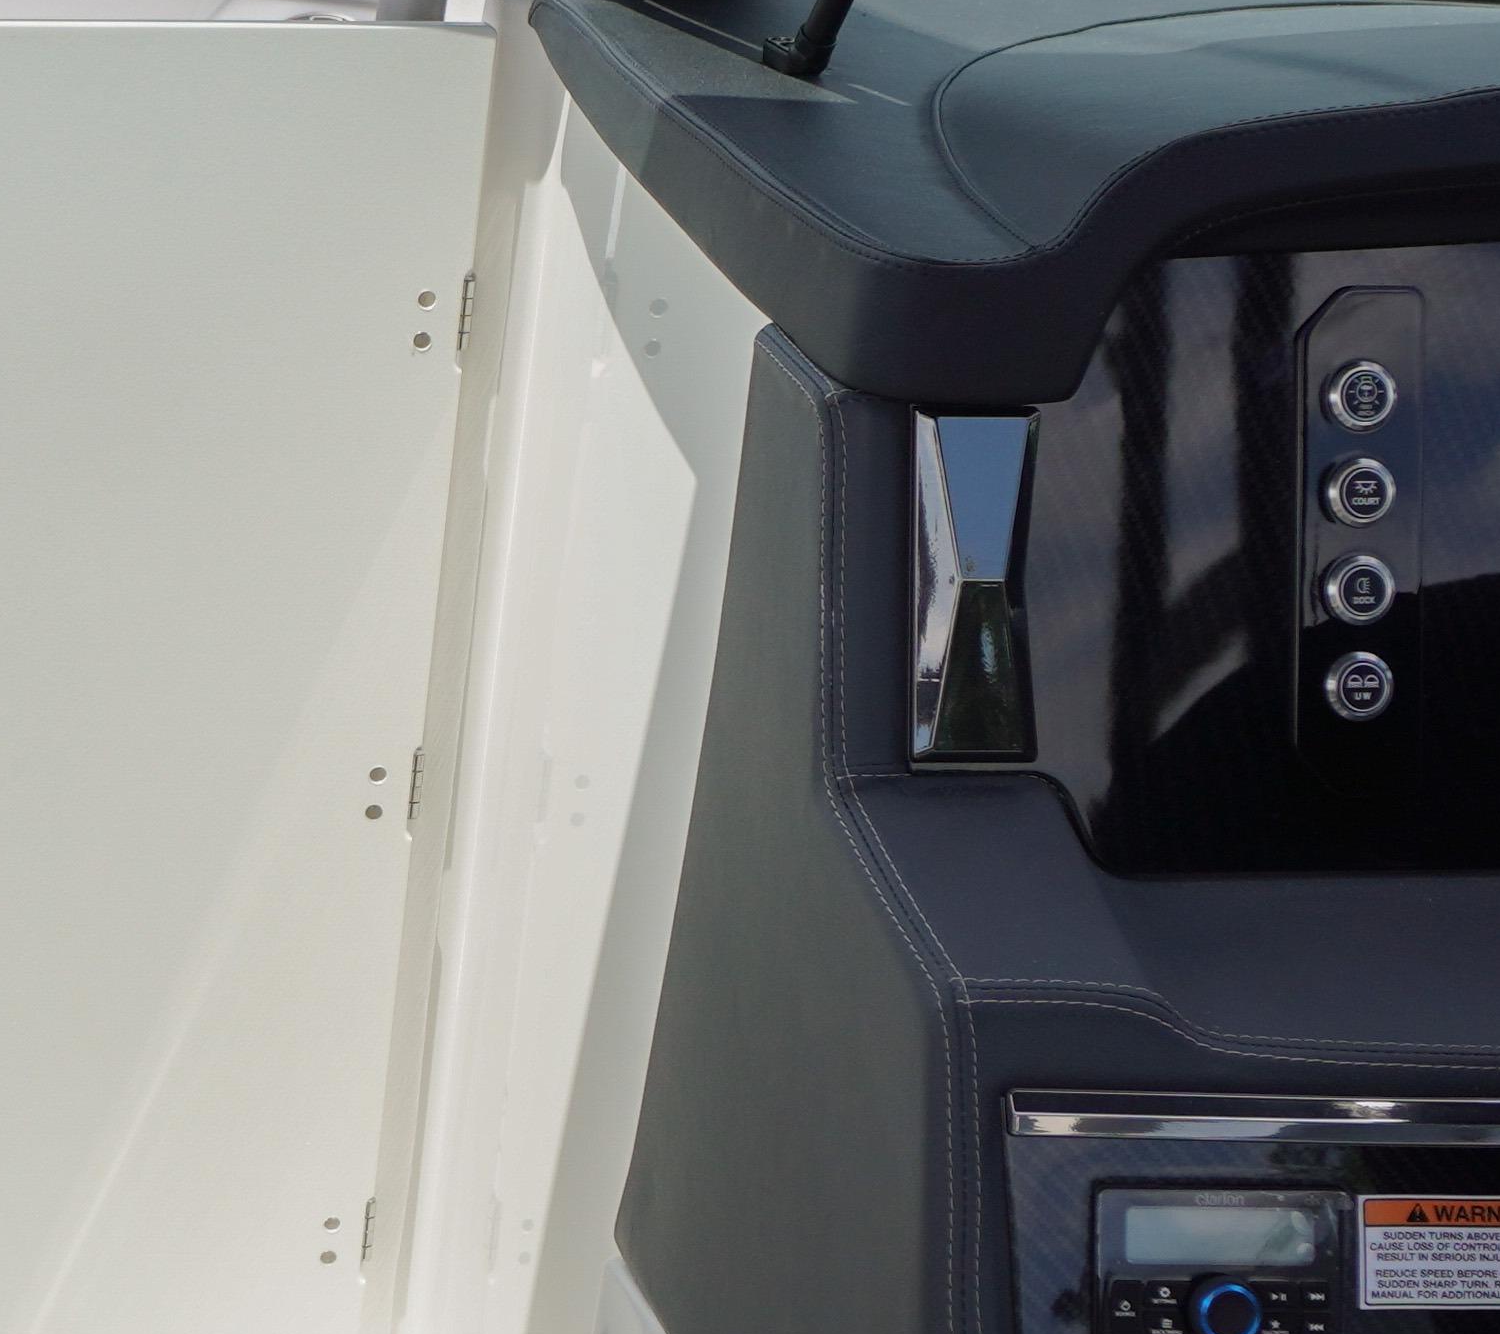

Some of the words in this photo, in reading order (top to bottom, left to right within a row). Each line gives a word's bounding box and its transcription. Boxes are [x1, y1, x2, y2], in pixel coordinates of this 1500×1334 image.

[1352, 496, 1380, 505] COURT
[1383, 1231, 1425, 1241] SUDDEN
[1429, 1231, 1463, 1241] TURNS
[1467, 1231, 1500, 1242] ABOVE
[1369, 1241, 1403, 1252] CAUSE
[1407, 1242, 1433, 1252] LOSS
[1436, 1242, 1449, 1252] OF
[1453, 1242, 1500, 1252] CONTROL
[1376, 1252, 1413, 1262] RESULT
[1418, 1252, 1428, 1262] IN
[1431, 1252, 1475, 1263] SERIOUS
[1375, 1269, 1416, 1279] REDUCE
[1420, 1269, 1453, 1279] SPEED
[1457, 1269, 1497, 1280] BEFORE
[1377, 1278, 1419, 1289] SUDDEN
[1422, 1279, 1456, 1289] SHARP
[1371, 1289, 1412, 1299] MANUAL
[1417, 1289, 1437, 1299] FOR
[1441, 1289, 1500, 1300] ADDITIONAL
